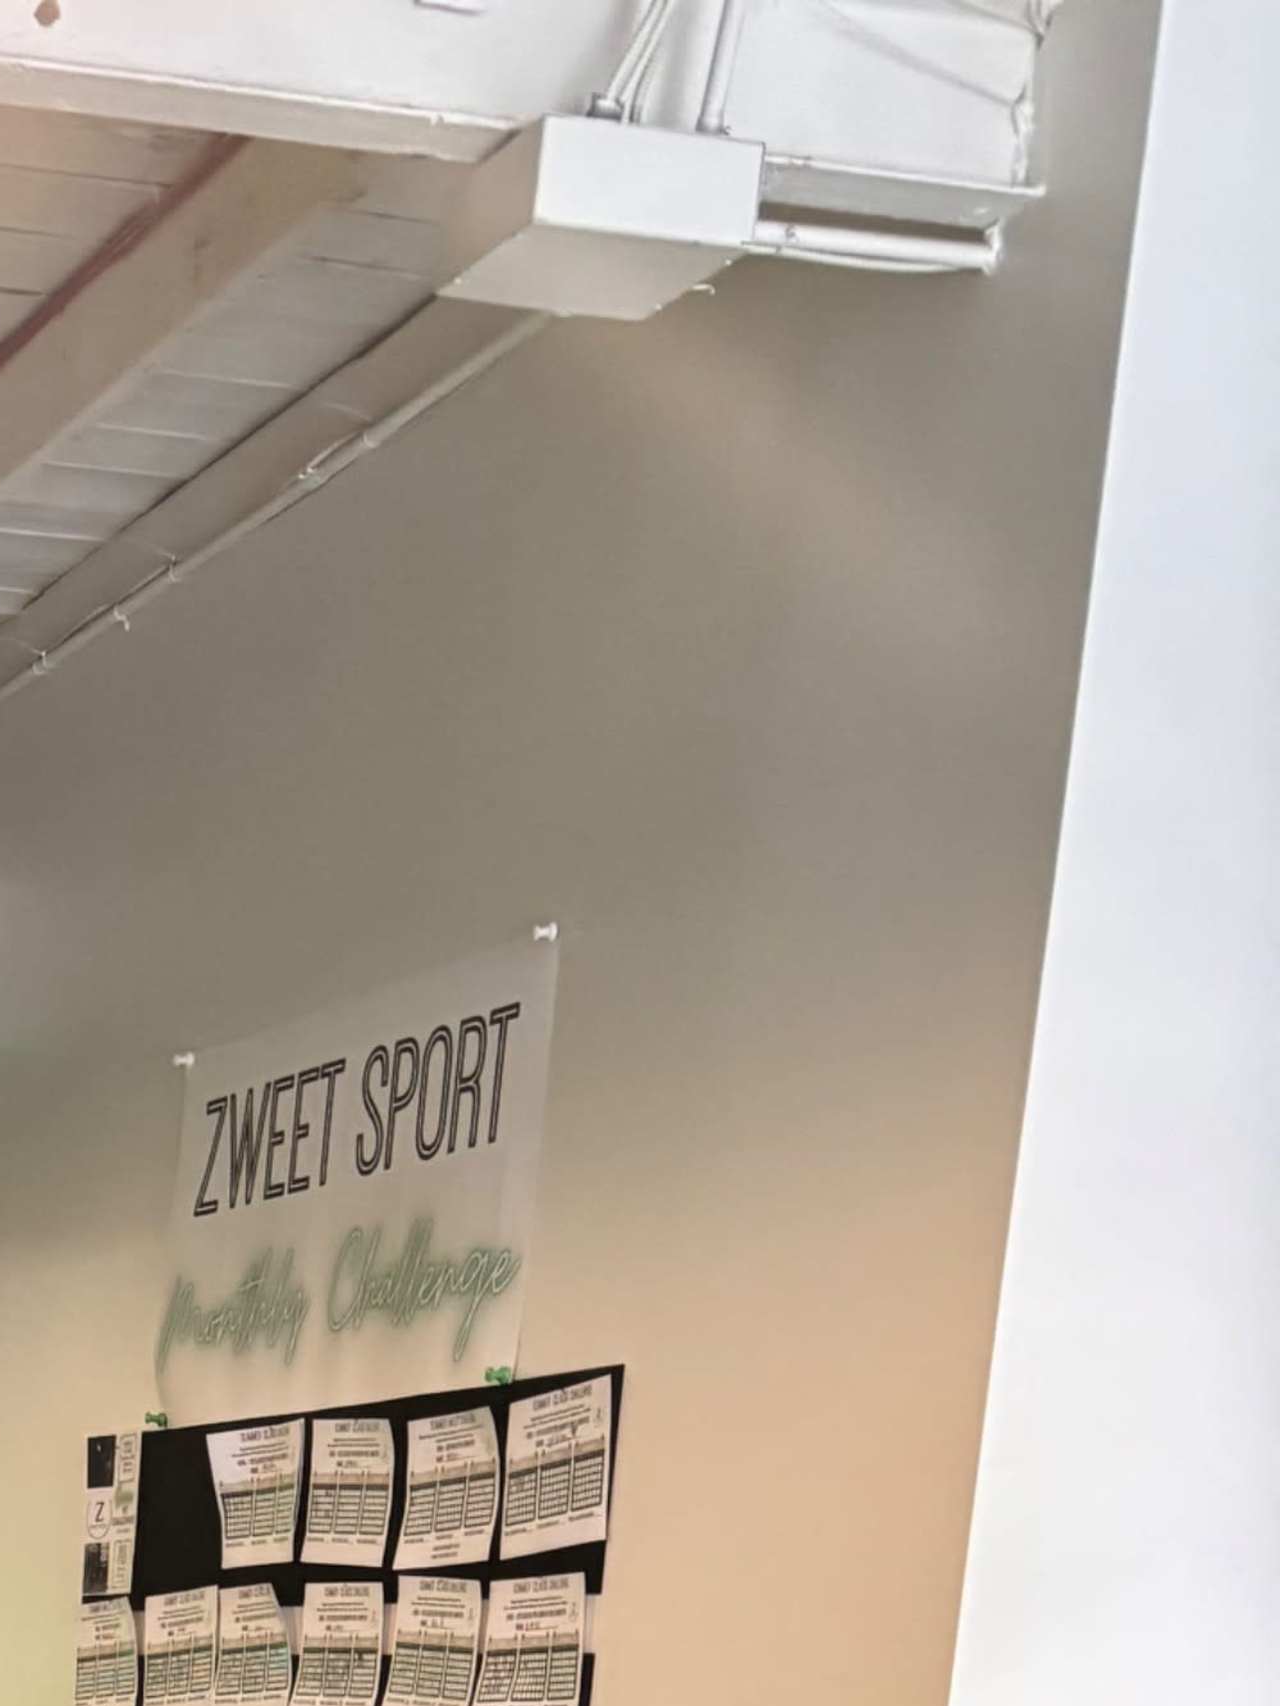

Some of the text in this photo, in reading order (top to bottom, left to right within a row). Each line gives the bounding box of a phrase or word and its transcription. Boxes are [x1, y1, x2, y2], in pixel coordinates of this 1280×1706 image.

[194, 1002, 521, 1217] ZWEET SPORT
[158, 1220, 521, 1374] Monthly Challenge
